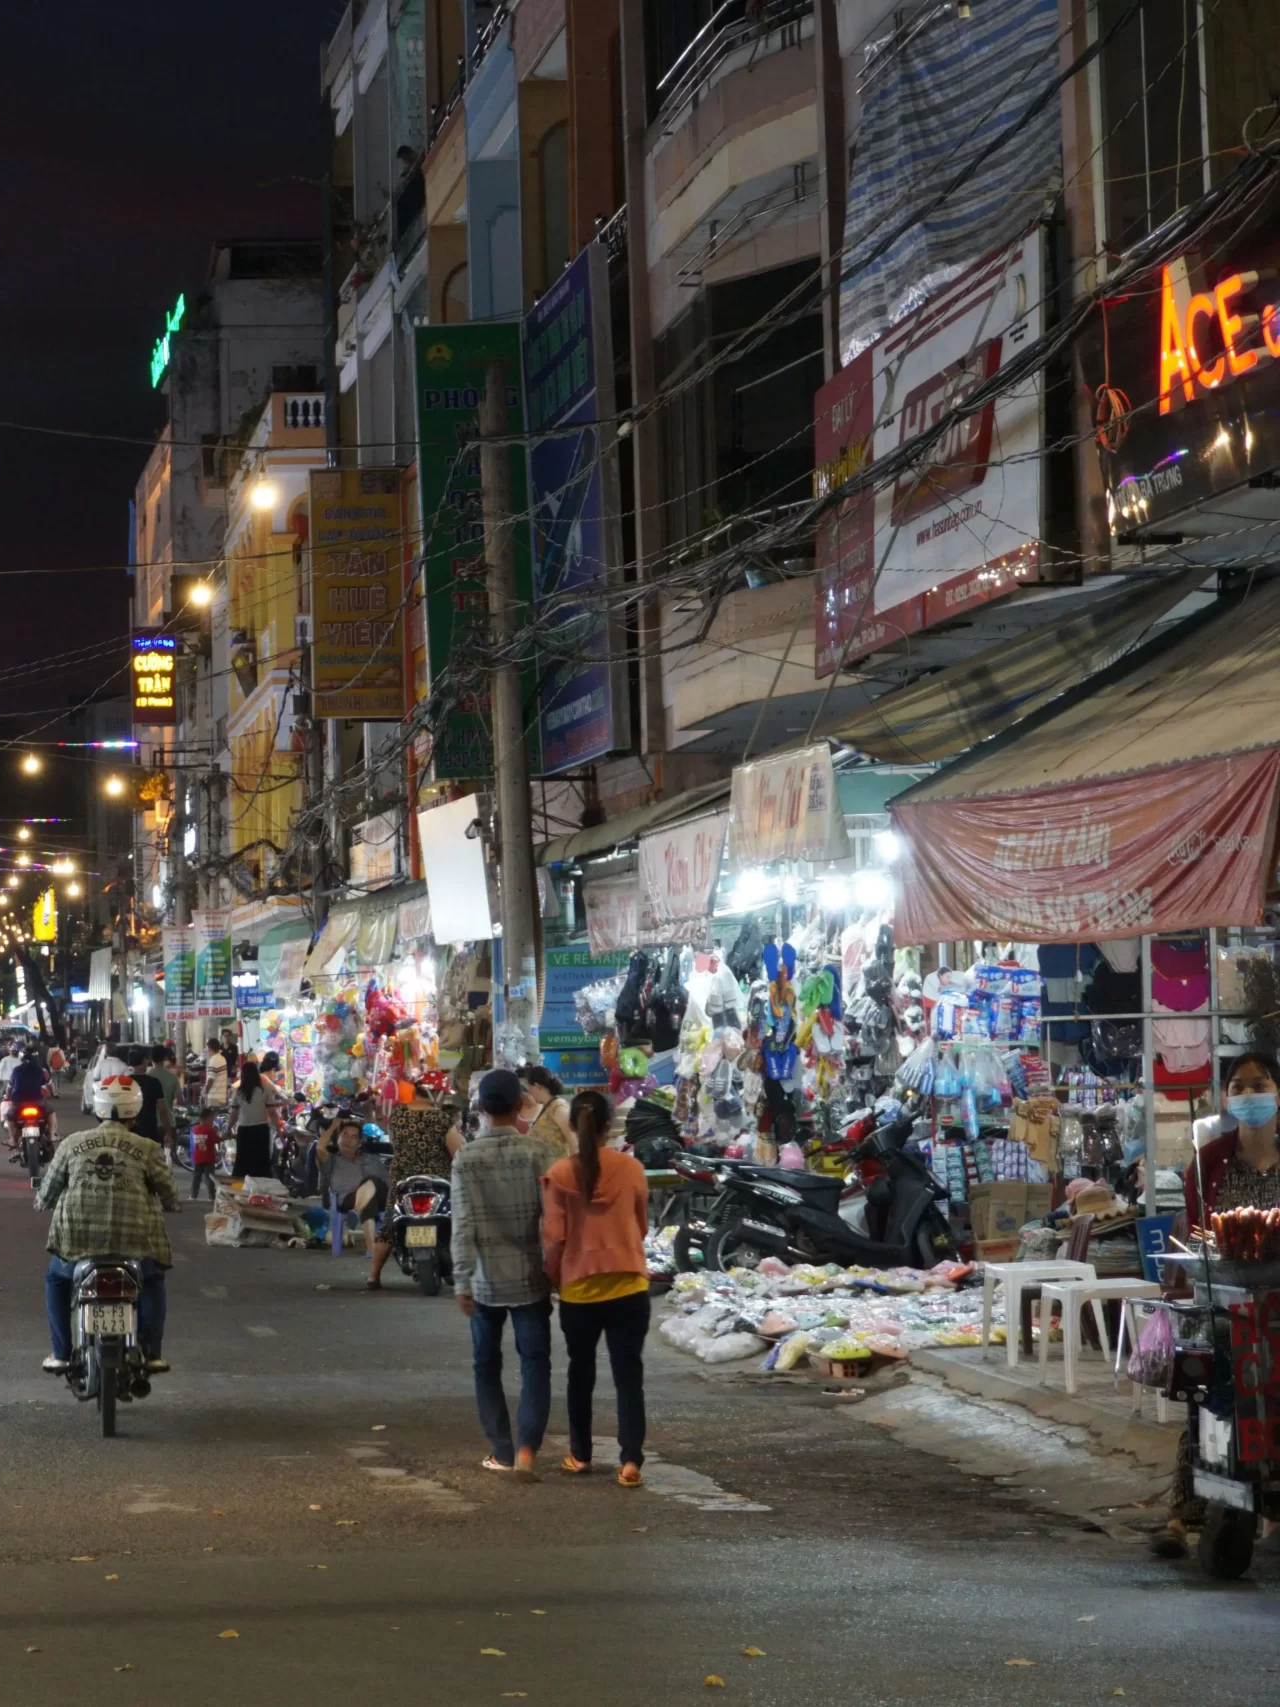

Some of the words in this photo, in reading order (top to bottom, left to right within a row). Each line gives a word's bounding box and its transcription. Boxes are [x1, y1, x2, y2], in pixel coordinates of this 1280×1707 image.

[1159, 264, 1258, 416] ACE
[424, 383, 519, 411] PHÒG
[327, 547, 388, 577] TÂN
[328, 580, 388, 613] HUÊ
[72, 1136, 144, 1161] REBELLIOUS
[92, 1320, 125, 1333] 6423
